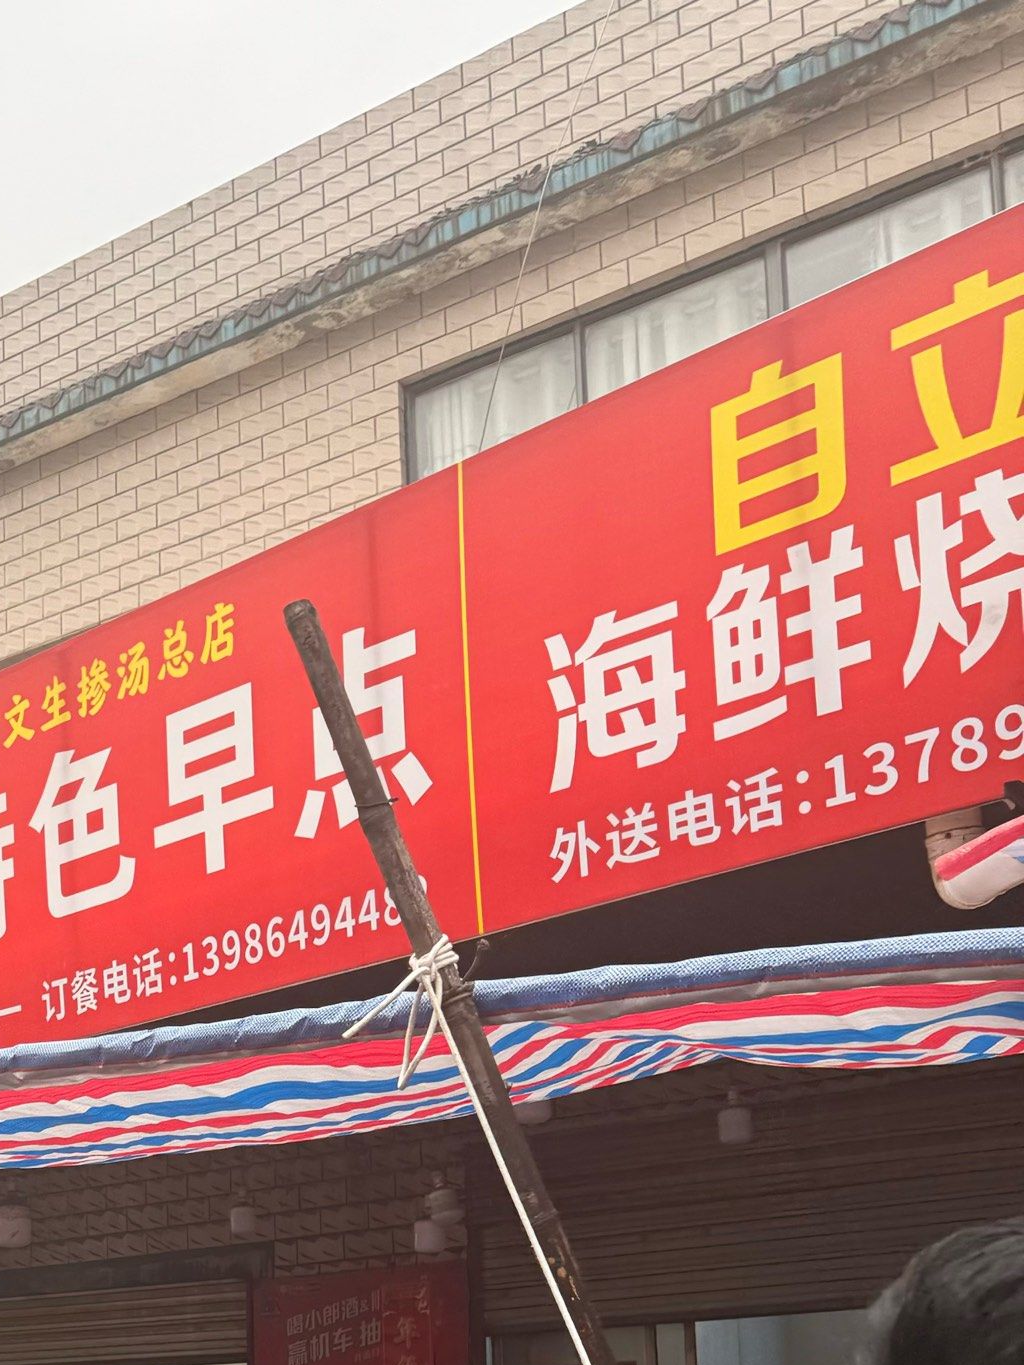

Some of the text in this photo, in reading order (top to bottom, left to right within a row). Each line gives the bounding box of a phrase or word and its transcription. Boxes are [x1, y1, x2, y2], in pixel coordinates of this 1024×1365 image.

[711, 269, 1024, 556] 自立
[41, 873, 428, 1023] 订餐电话:1398649448
